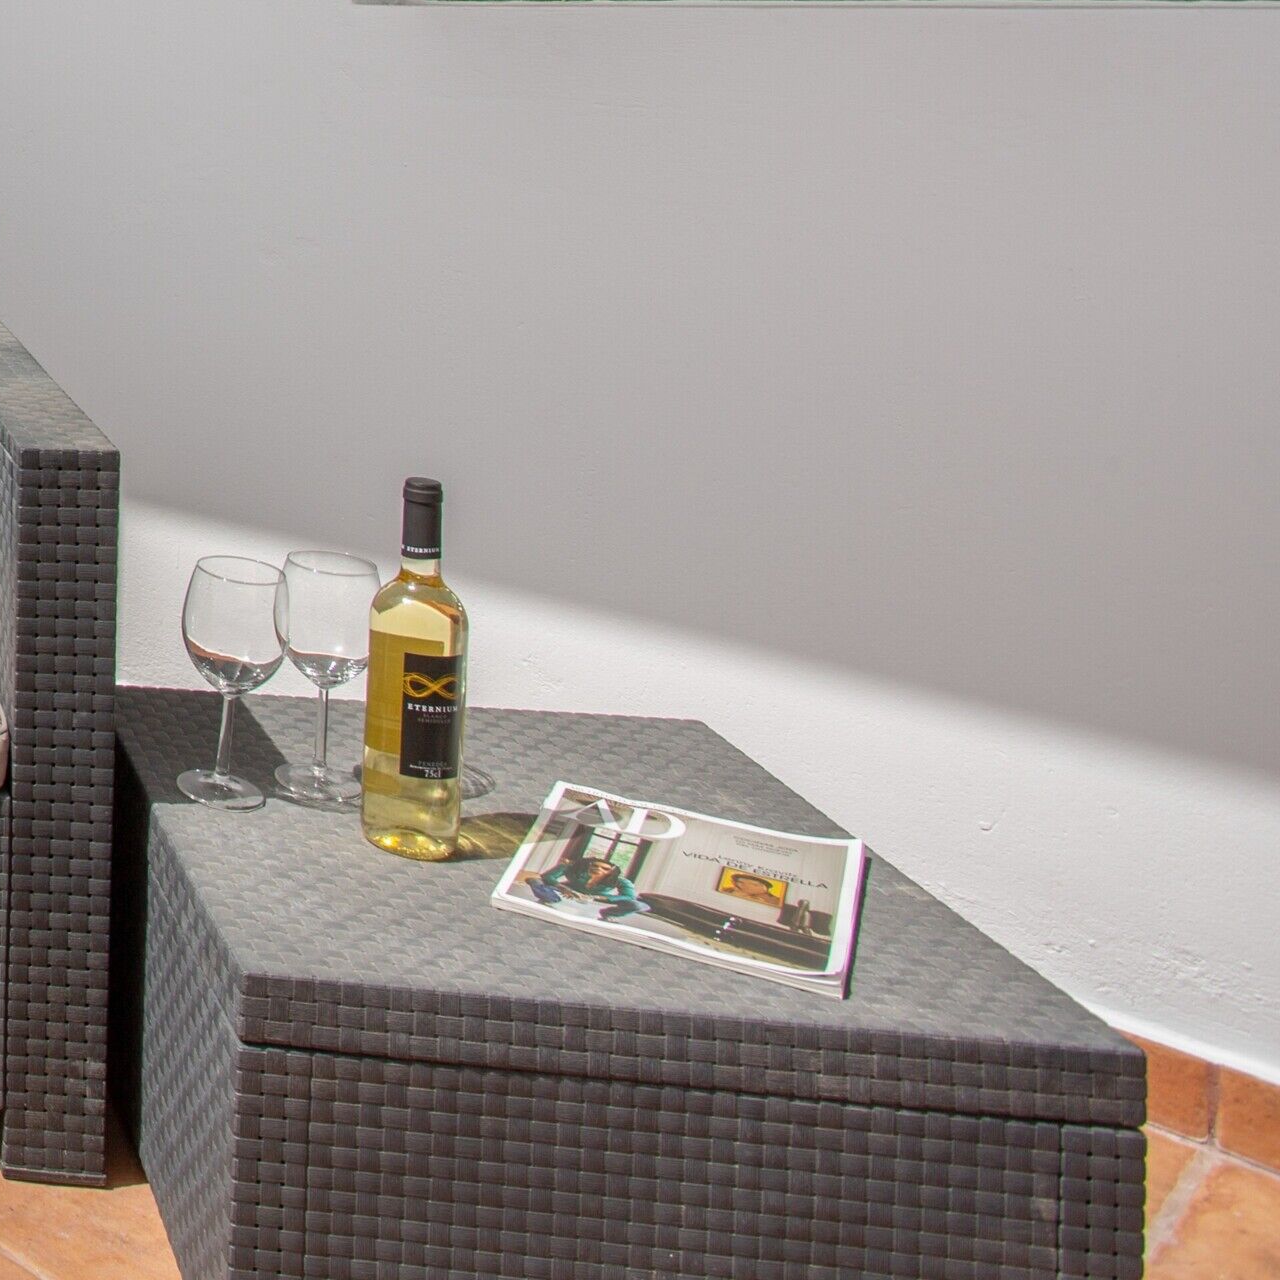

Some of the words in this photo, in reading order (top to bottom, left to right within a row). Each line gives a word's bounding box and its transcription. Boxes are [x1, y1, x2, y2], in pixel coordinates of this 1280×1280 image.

[407, 545, 439, 553] ETERNIUM
[407, 702, 458, 713] ETERNIUM
[424, 769, 441, 778] 75cl
[559, 798, 687, 839] AD
[683, 851, 720, 864] VIDA
[727, 860, 745, 870] DE
[753, 868, 828, 889] ESTRELLA
